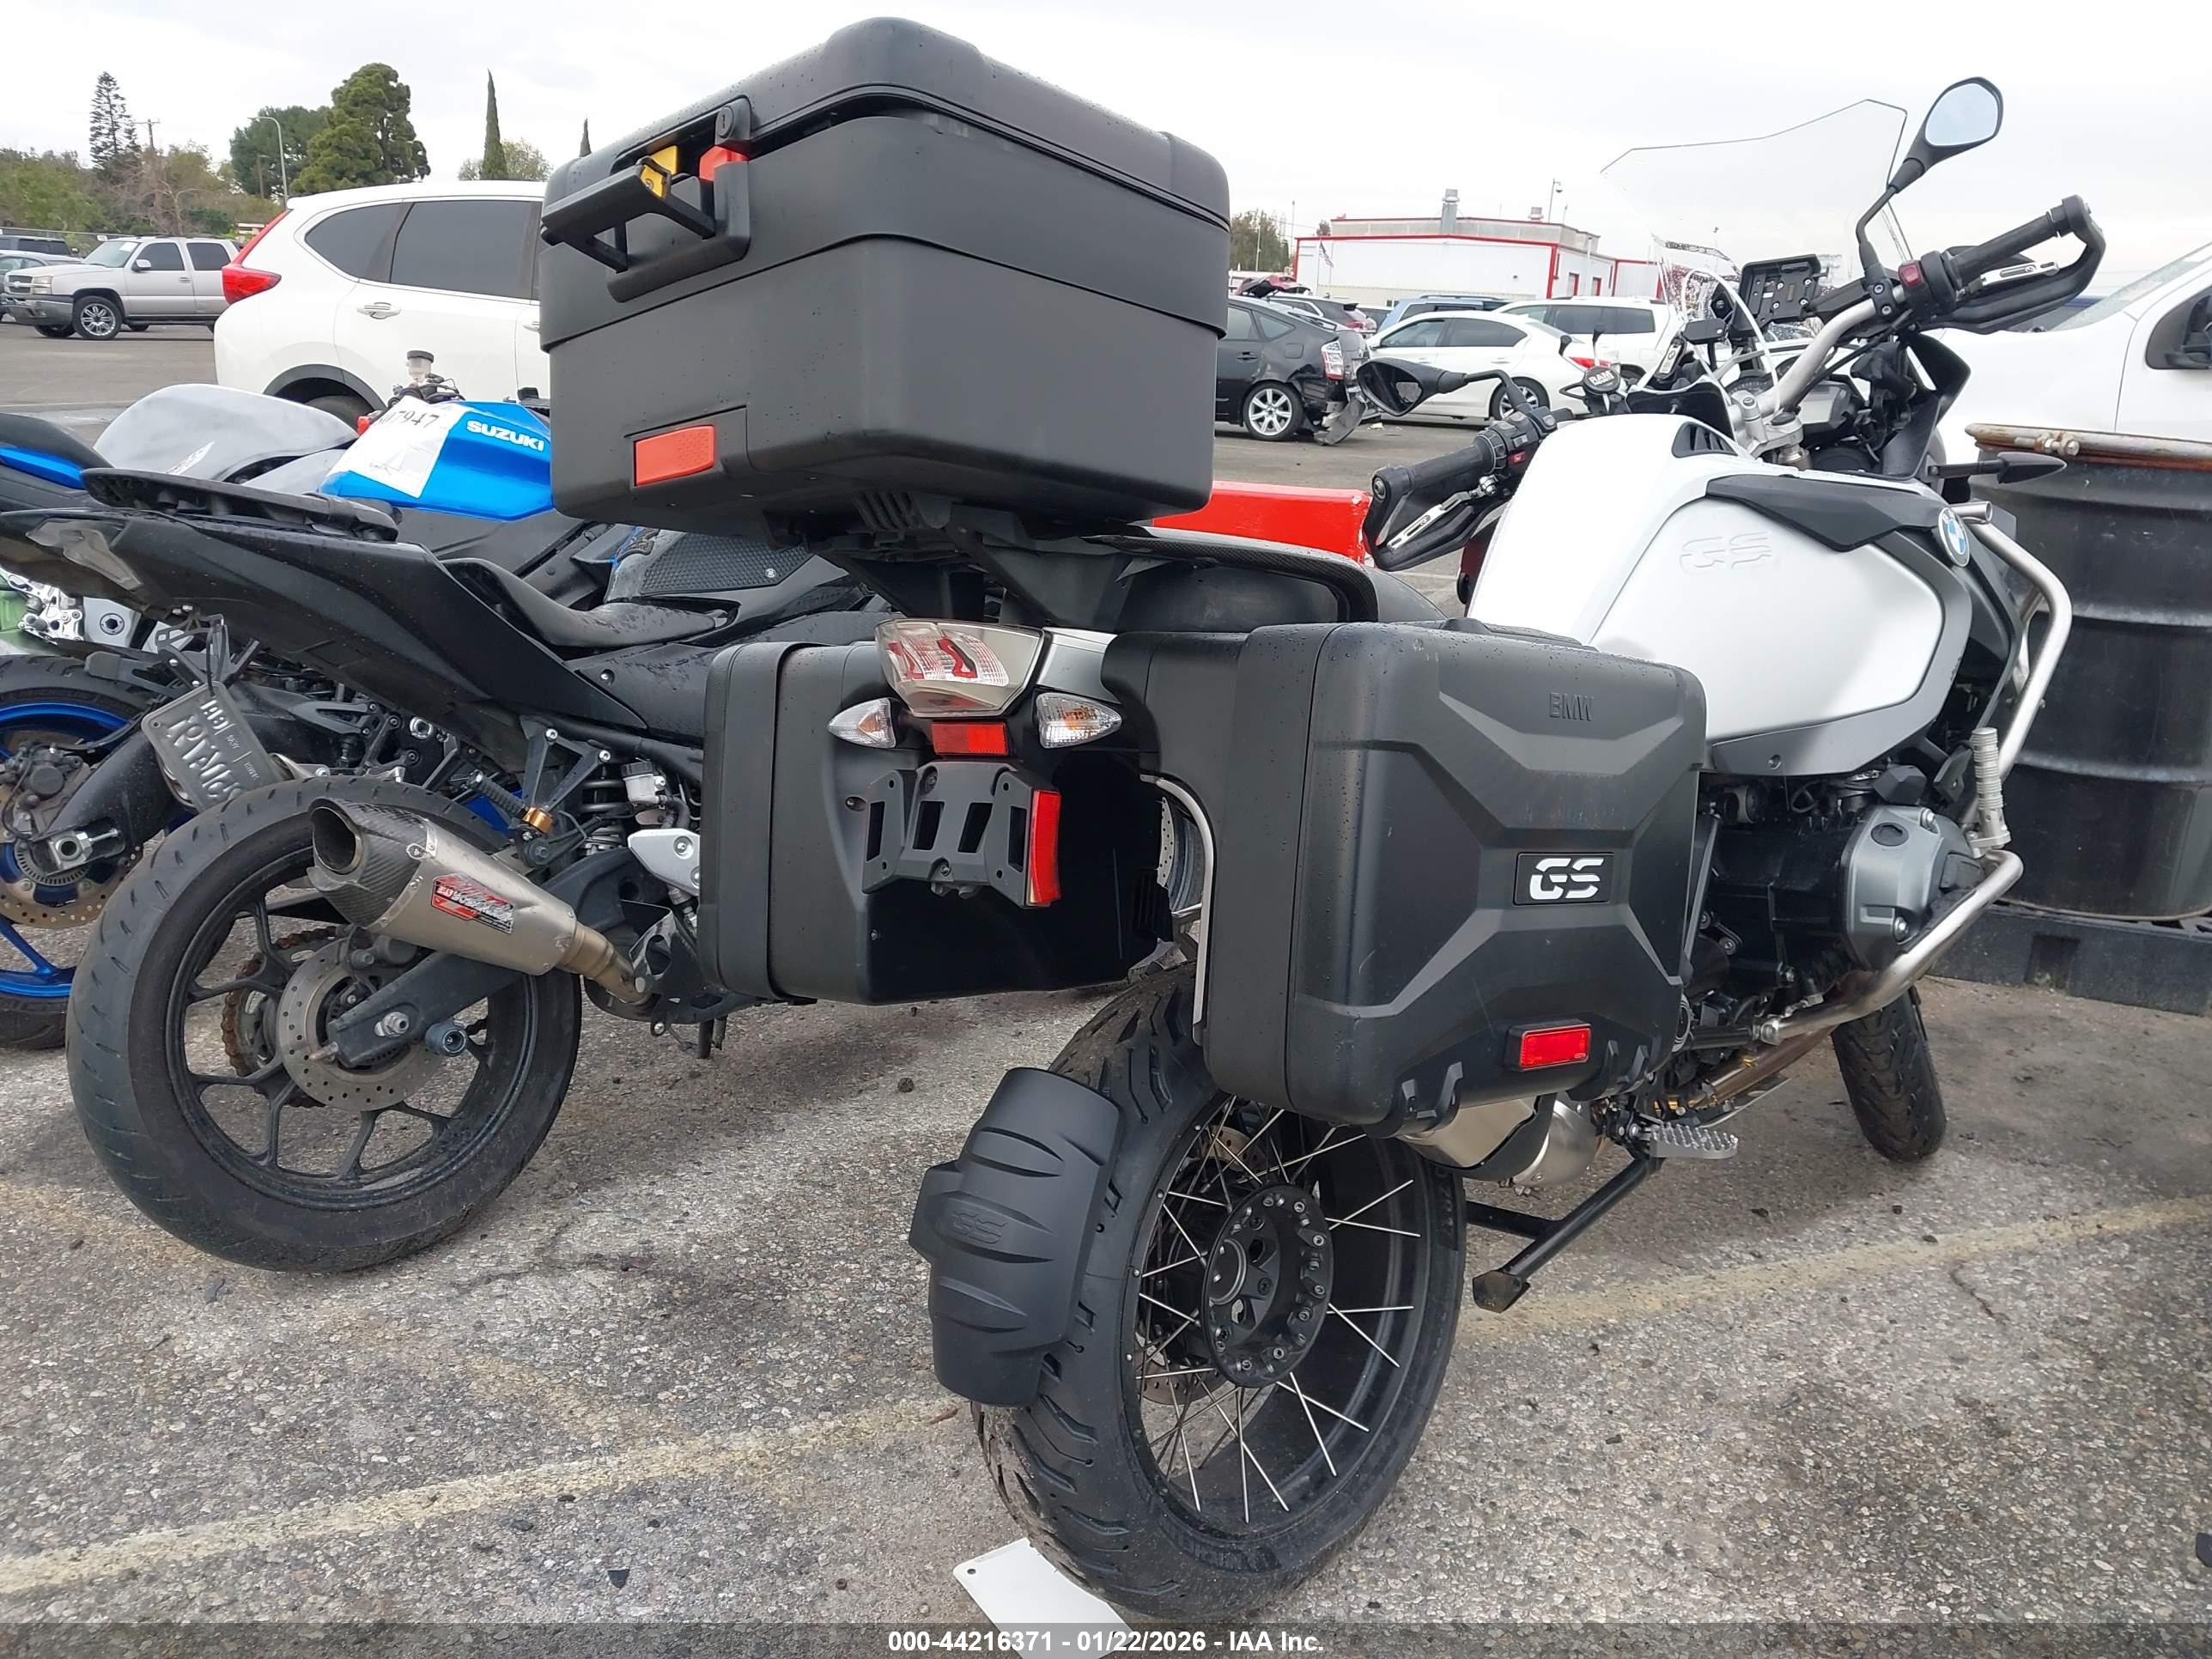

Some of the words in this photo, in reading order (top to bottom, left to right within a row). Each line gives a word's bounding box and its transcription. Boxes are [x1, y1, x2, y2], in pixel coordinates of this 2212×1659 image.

[466, 420, 545, 452] SUZUKI
[1679, 532, 1772, 574] GS
[1548, 692, 1594, 721] BMW
[1529, 858, 1605, 900] GS
